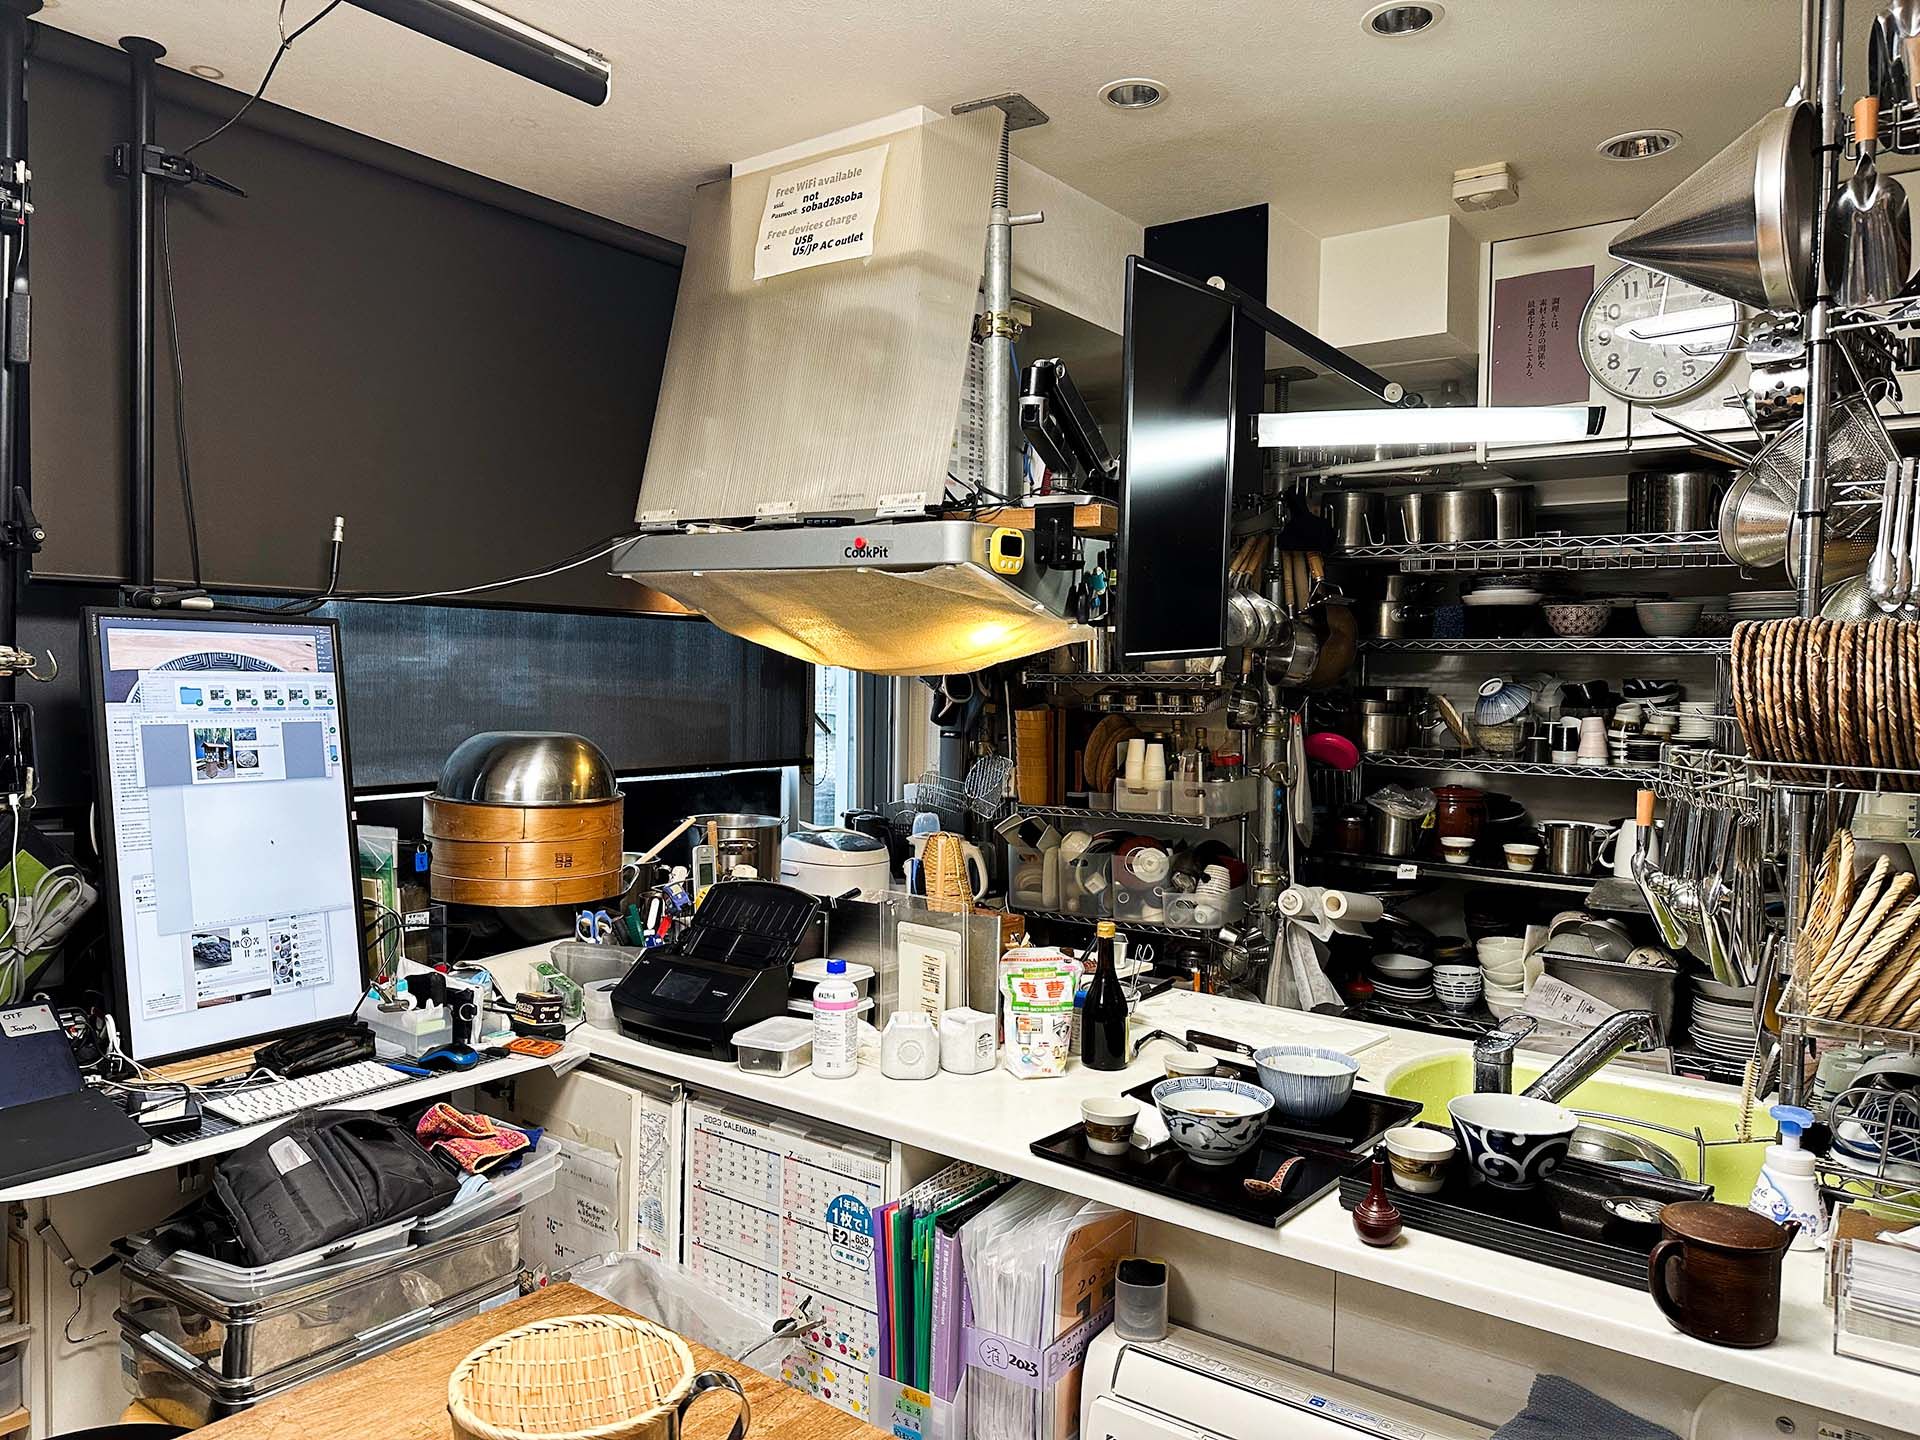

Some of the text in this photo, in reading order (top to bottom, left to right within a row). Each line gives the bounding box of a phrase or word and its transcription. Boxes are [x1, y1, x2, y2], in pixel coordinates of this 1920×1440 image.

[775, 167, 863, 198] Free WiFi available
[800, 190, 863, 214] sobad28soba
[802, 191, 819, 203] not
[766, 212, 858, 240] Free devices charge
[792, 232, 864, 256] US/JP AC outlet
[794, 234, 814, 246] USB
[1624, 281, 1638, 299] 11
[1602, 303, 1621, 321] 10
[1598, 330, 1612, 346] 9
[1607, 352, 1621, 370] 8
[1682, 359, 1696, 377] 5
[1627, 367, 1641, 385] 7
[1653, 370, 1667, 388] 6
[844, 546, 889, 558] CookPit
[1018, 981, 1065, 998] 重曹
[703, 1114, 722, 1127] 2023
[723, 1120, 757, 1137] CALENDAR
[832, 1228, 869, 1247] E2 638
[1008, 1353, 1039, 1377] 2023
